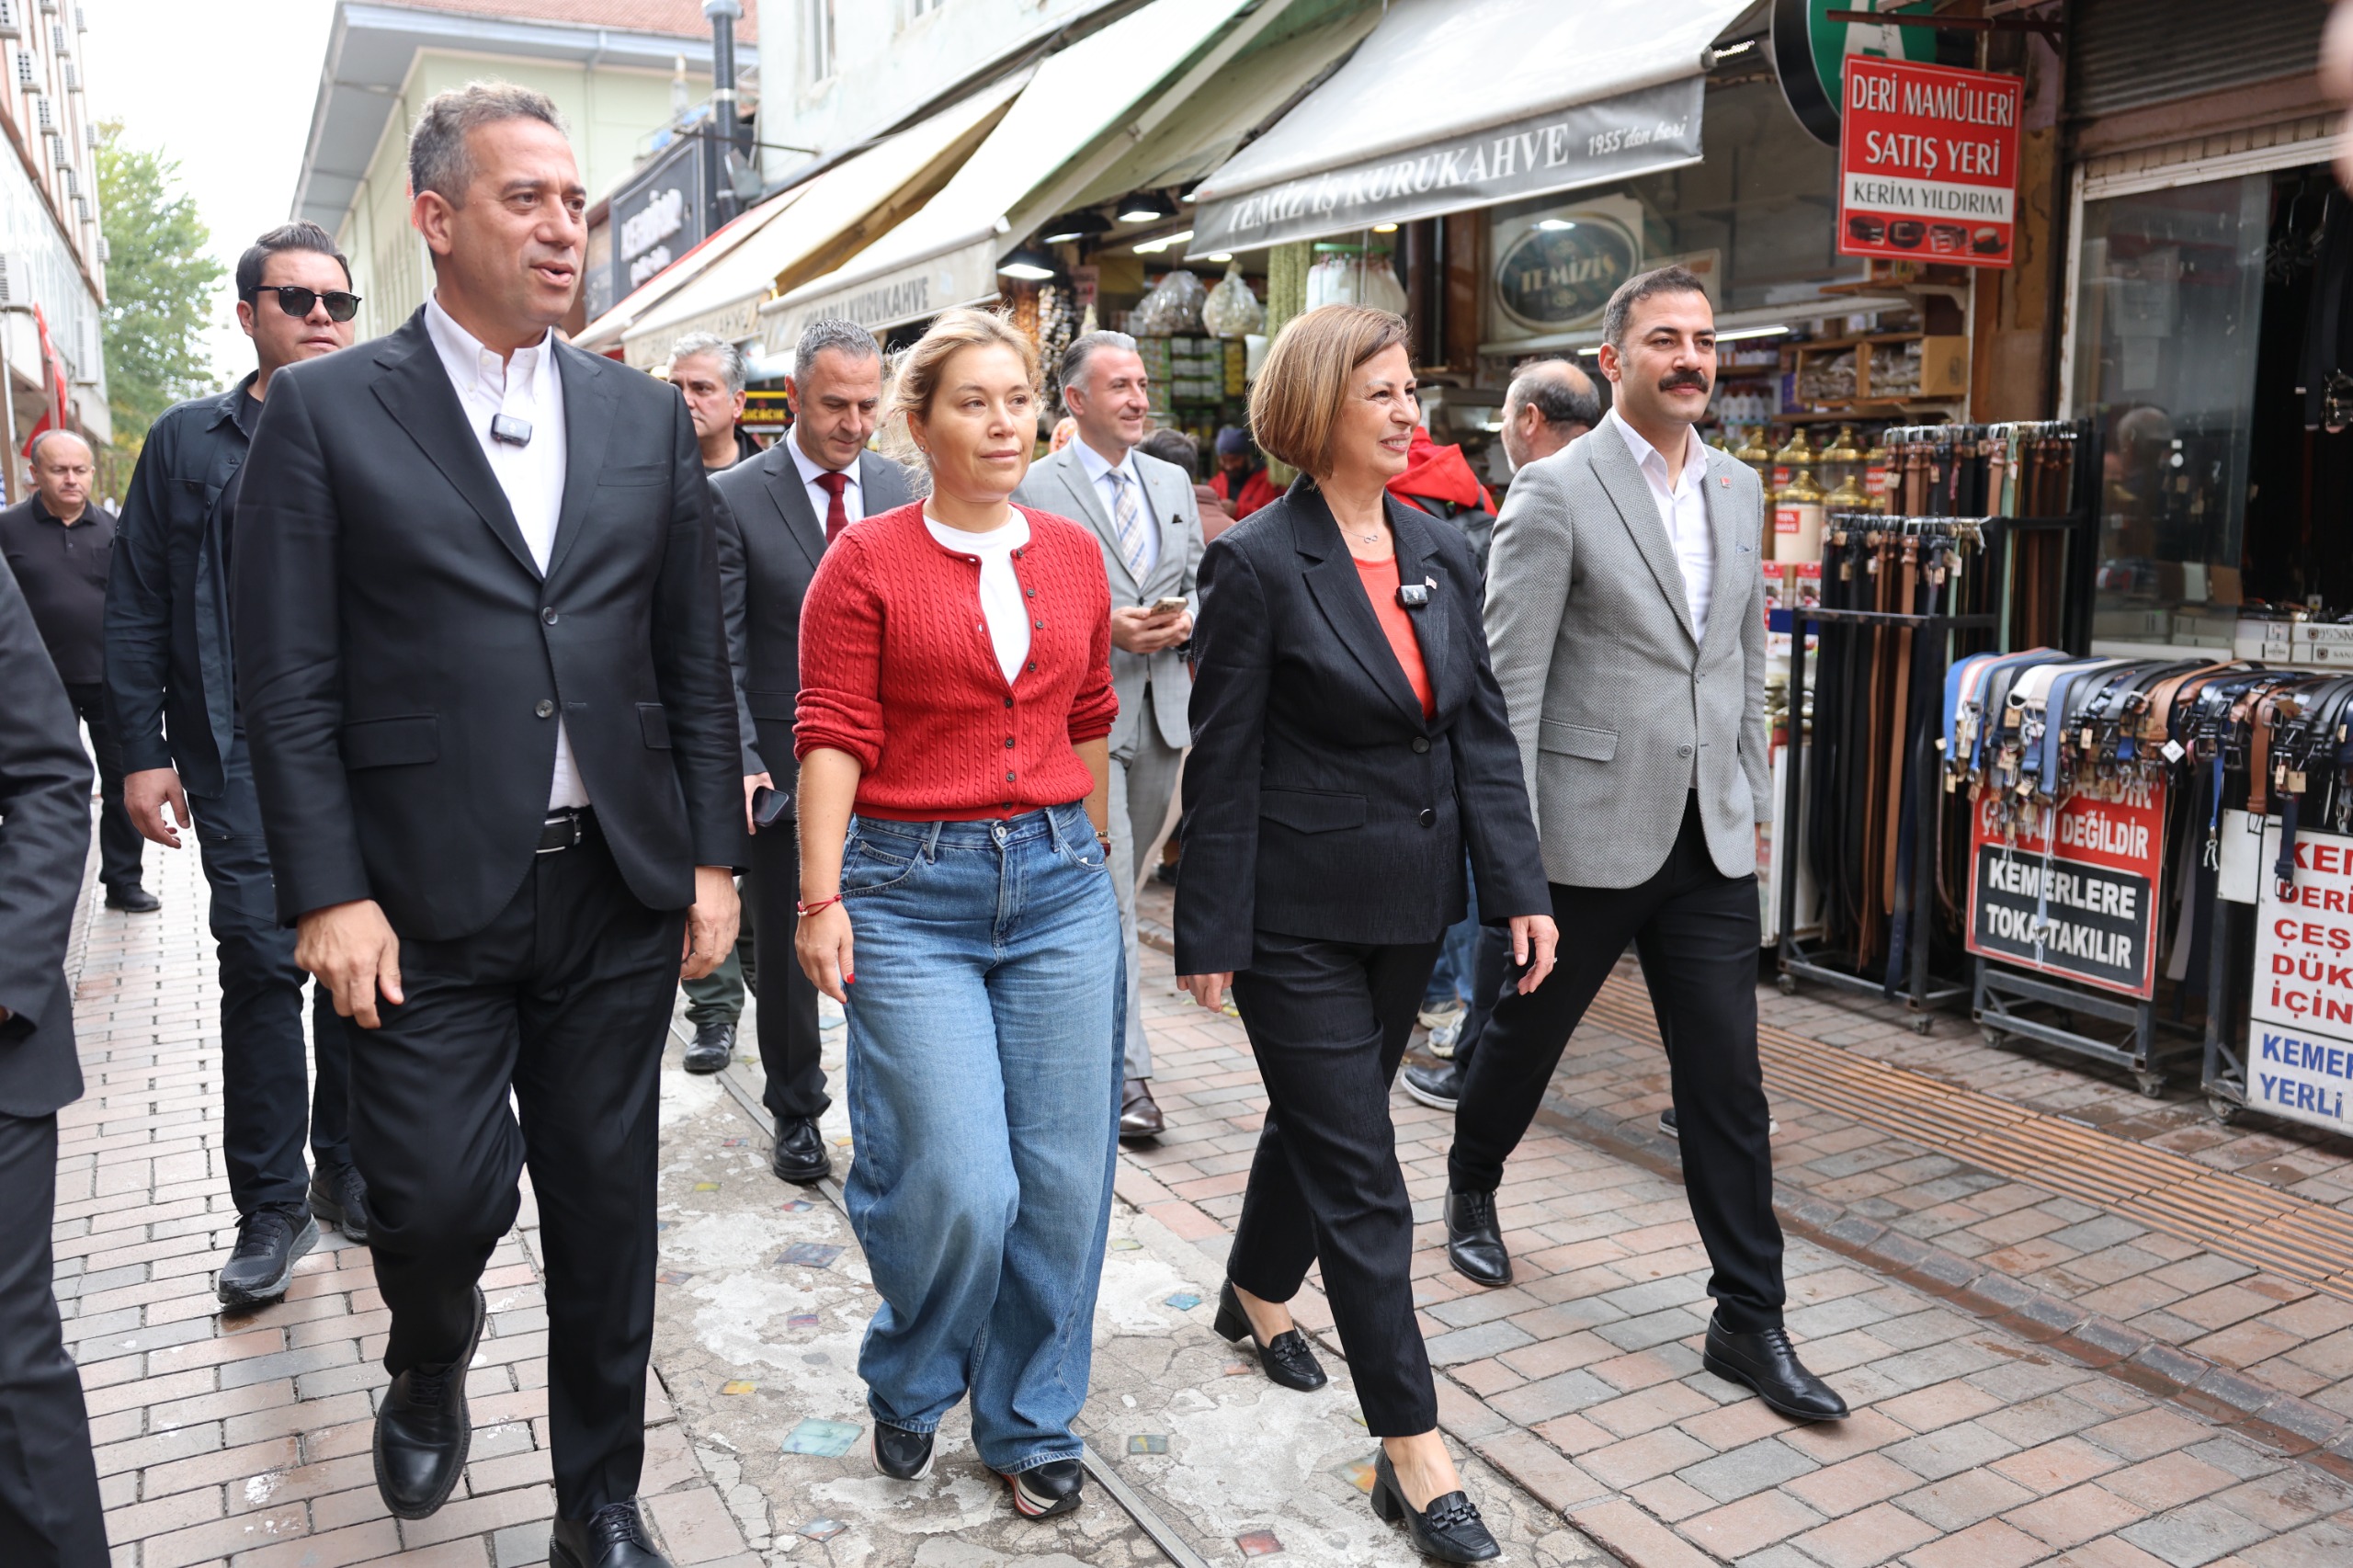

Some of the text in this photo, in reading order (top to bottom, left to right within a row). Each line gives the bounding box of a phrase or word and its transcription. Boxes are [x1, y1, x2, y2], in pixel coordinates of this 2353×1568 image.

[1852, 73, 2015, 128] DERİ MAMÜLLERİ
[1227, 180, 1307, 233] TEMİZ
[1343, 122, 1569, 209] KURUKAHVE
[1653, 115, 1688, 142] beri
[1865, 131, 2001, 177] SATIŞ YERİ
[1854, 181, 2004, 215] KERİM YILDIRIM
[2061, 809, 2149, 859] DEĞİLDİR
[1988, 857, 2137, 920] KEMERLERE
[1985, 903, 2132, 969] TOKA TAKILIR
[2274, 918, 2351, 958] ÇEŞ
[2272, 951, 2353, 989] DÜK
[2271, 980, 2353, 1025] İÇİN
[2259, 1073, 2343, 1119] YERLİ
